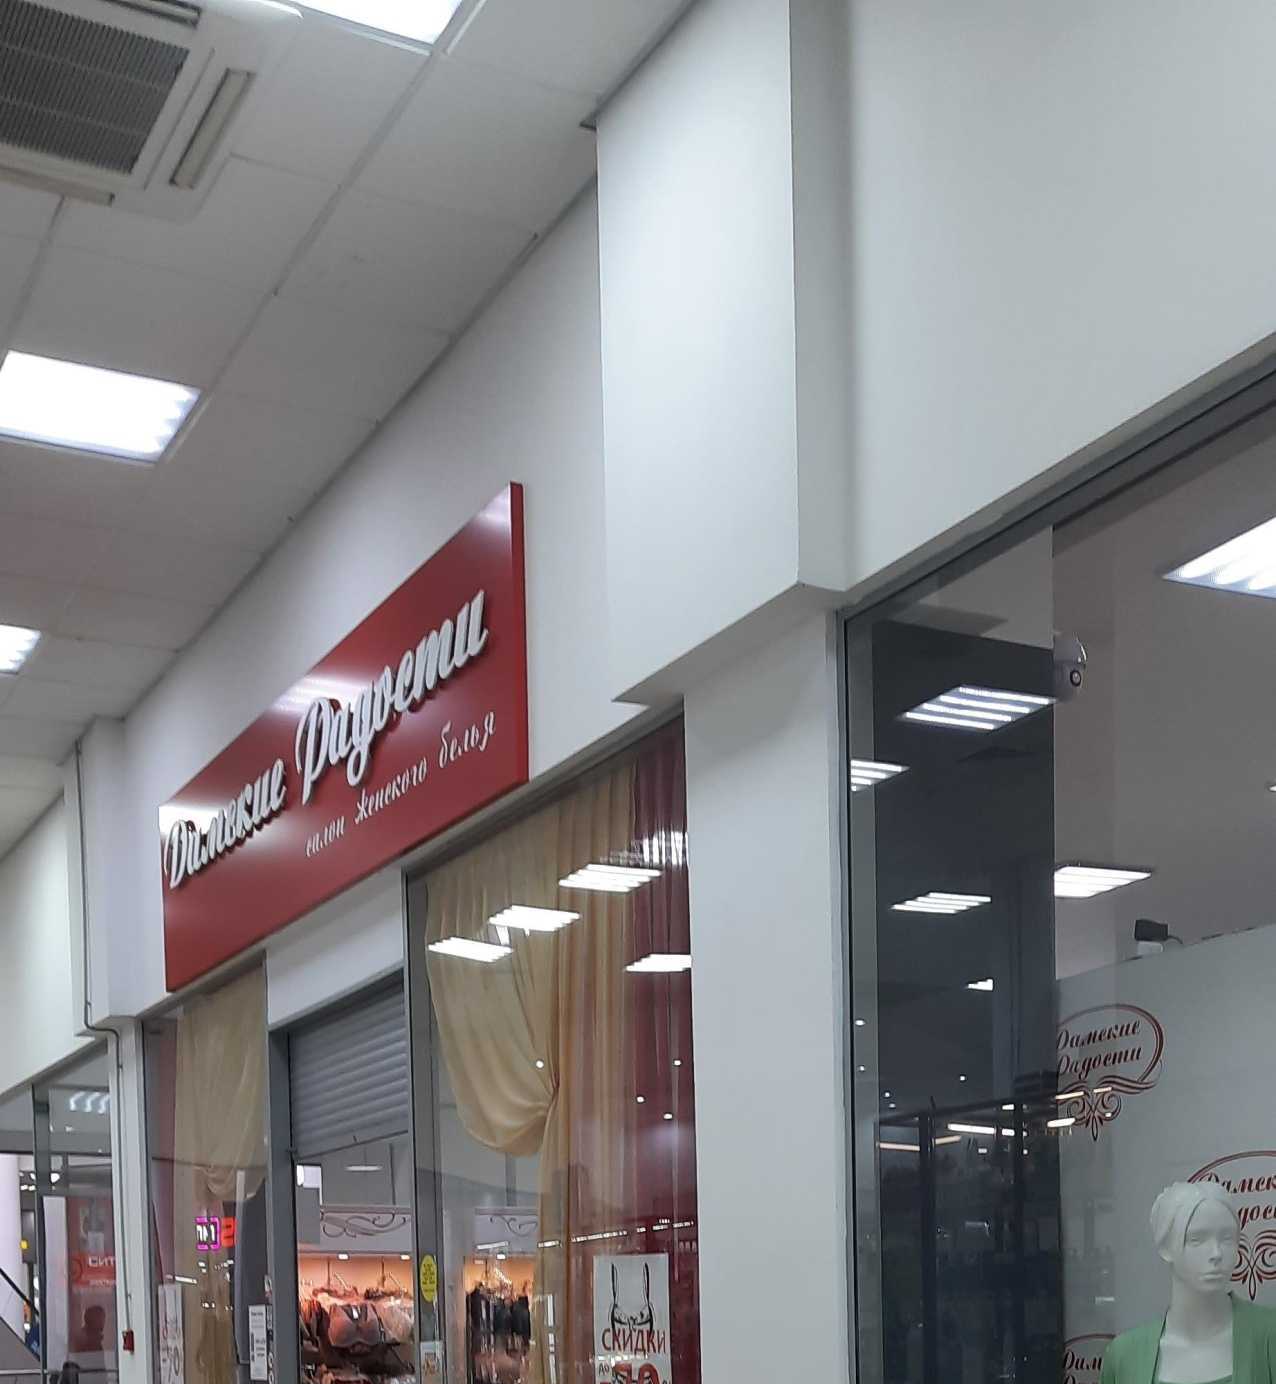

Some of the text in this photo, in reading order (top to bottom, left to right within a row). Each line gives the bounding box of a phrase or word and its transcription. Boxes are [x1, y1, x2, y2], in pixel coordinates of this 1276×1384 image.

[164, 590, 489, 888] Дамские Радости
[306, 711, 496, 858] салон женского белья
[1057, 1020, 1140, 1050] Дамские
[1056, 1047, 1142, 1081] Радости
[602, 1328, 666, 1357] СКИДКИ
